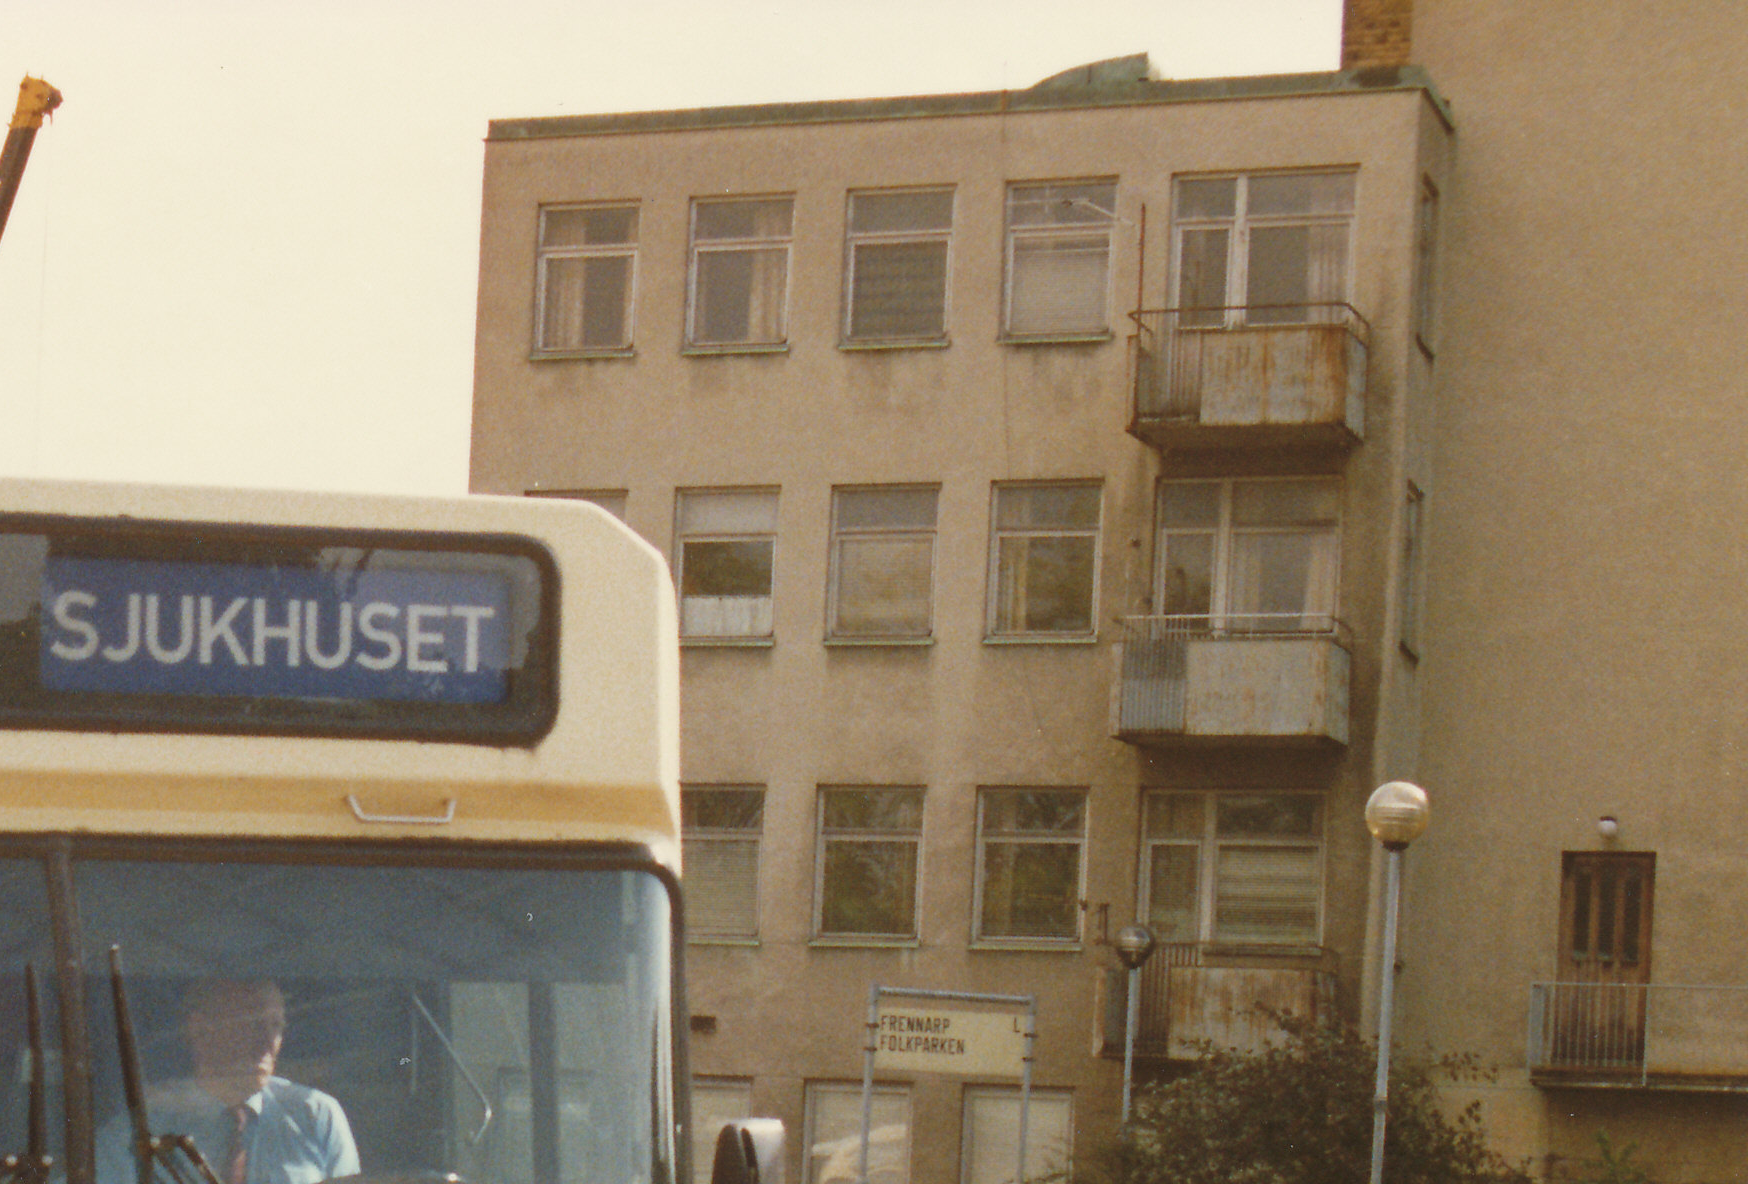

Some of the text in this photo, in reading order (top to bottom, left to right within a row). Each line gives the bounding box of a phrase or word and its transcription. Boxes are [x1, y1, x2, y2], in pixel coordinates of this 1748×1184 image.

[51, 592, 495, 674] SJUKHUSET
[880, 1015, 1021, 1034] FRENNARP L
[879, 1035, 965, 1055] FOLKPARKEN
